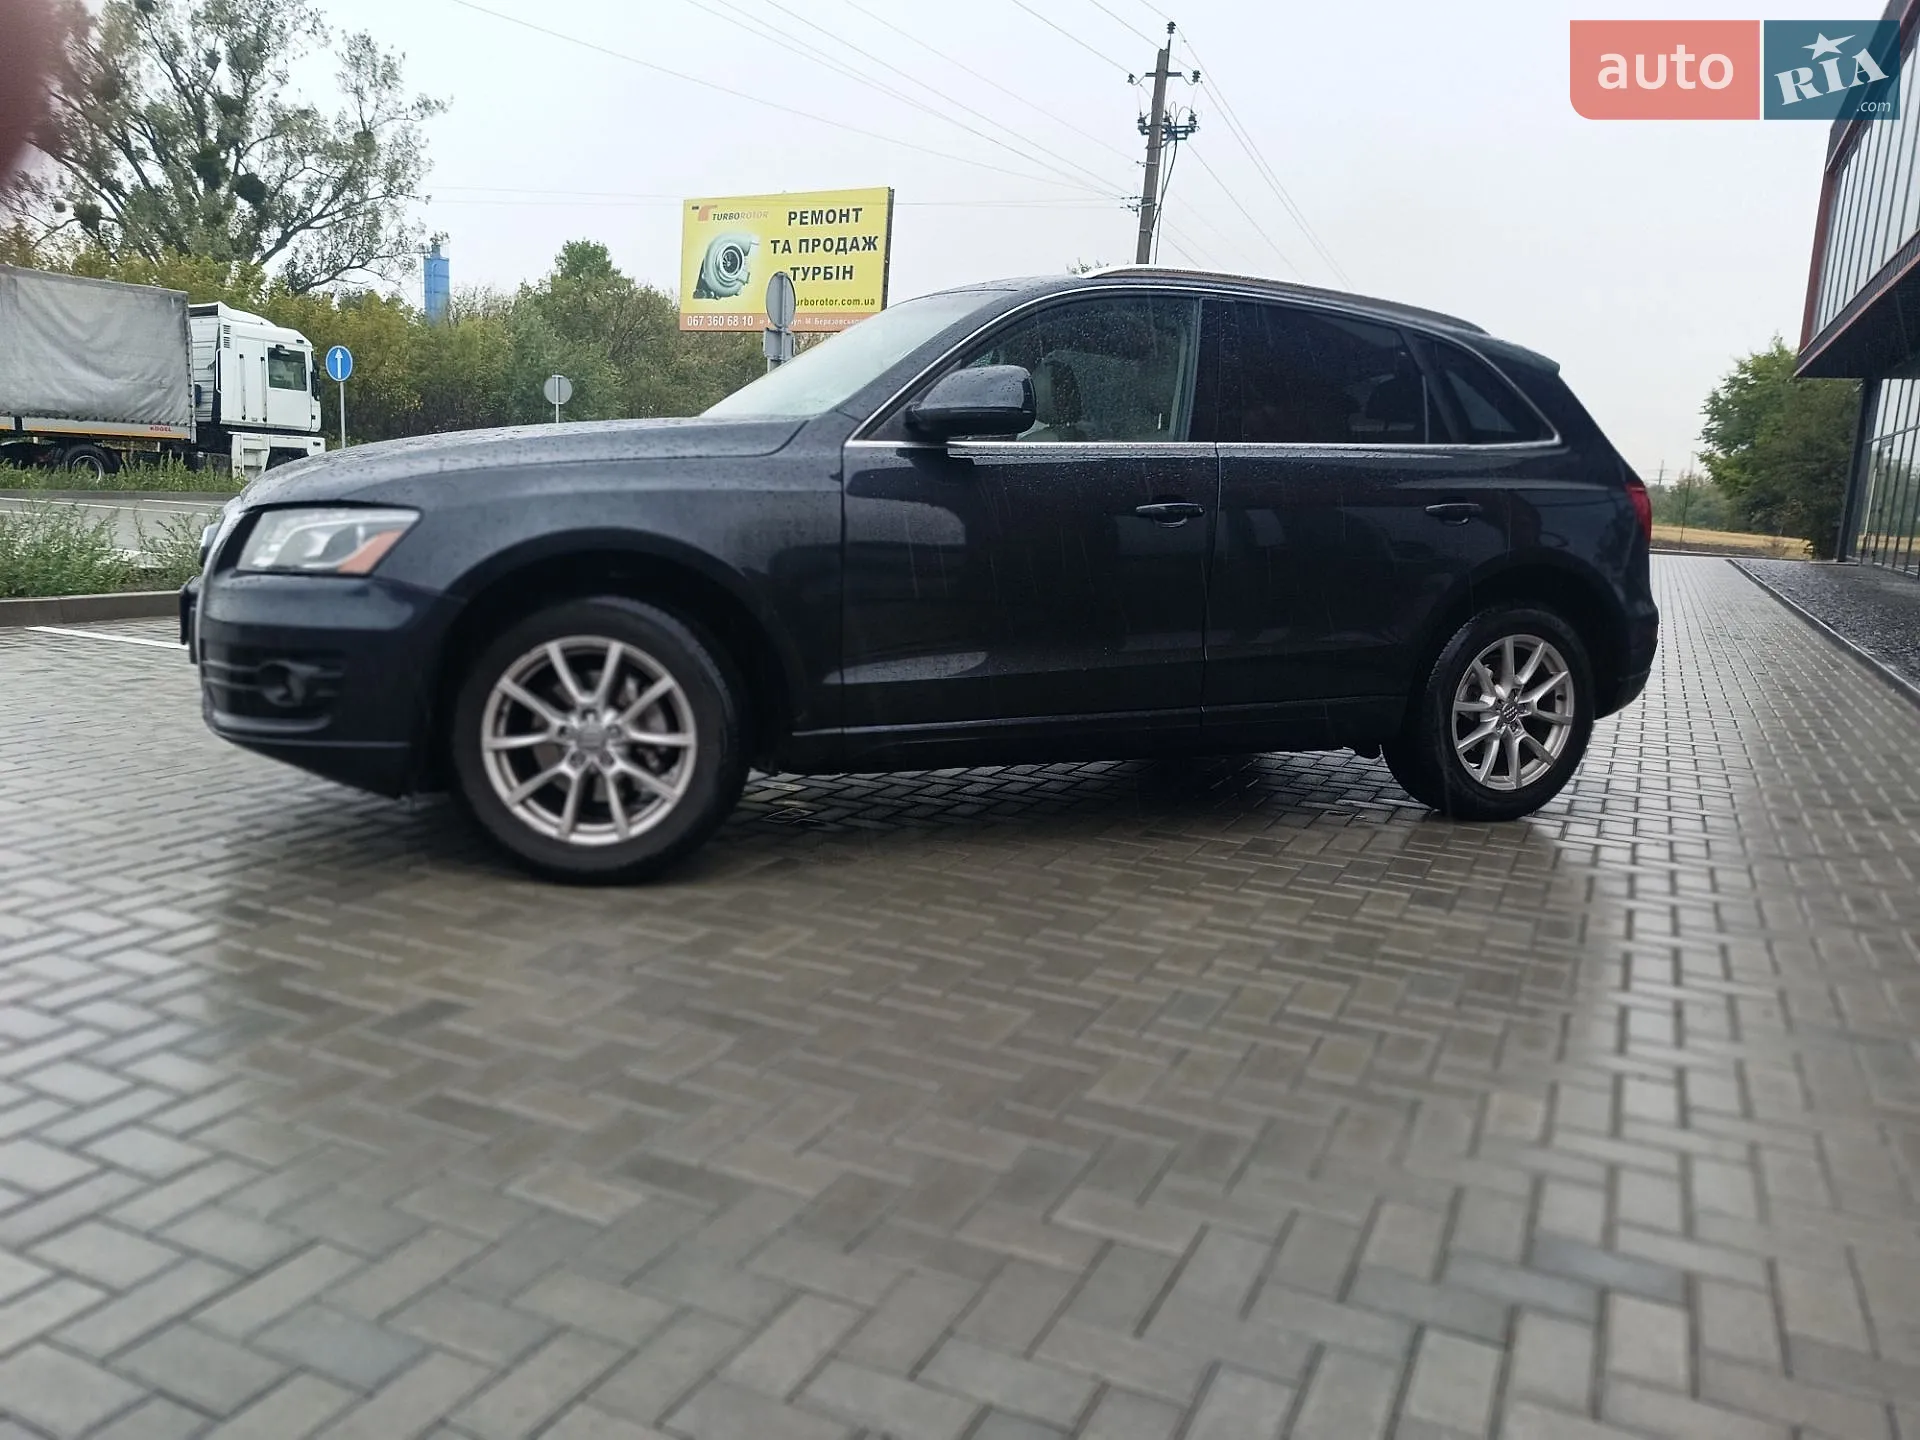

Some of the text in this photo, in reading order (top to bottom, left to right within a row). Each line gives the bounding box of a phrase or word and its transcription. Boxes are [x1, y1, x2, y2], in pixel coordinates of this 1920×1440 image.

[712, 212, 769, 221] TURBOROTOR
[788, 207, 863, 226] РЕМОНТ
[770, 236, 878, 255] ТА ПРОДАЖ
[790, 265, 854, 280] ТУРБІН
[796, 297, 875, 306] urborotor.com.ua
[687, 315, 704, 327] 067
[707, 315, 724, 327] 360
